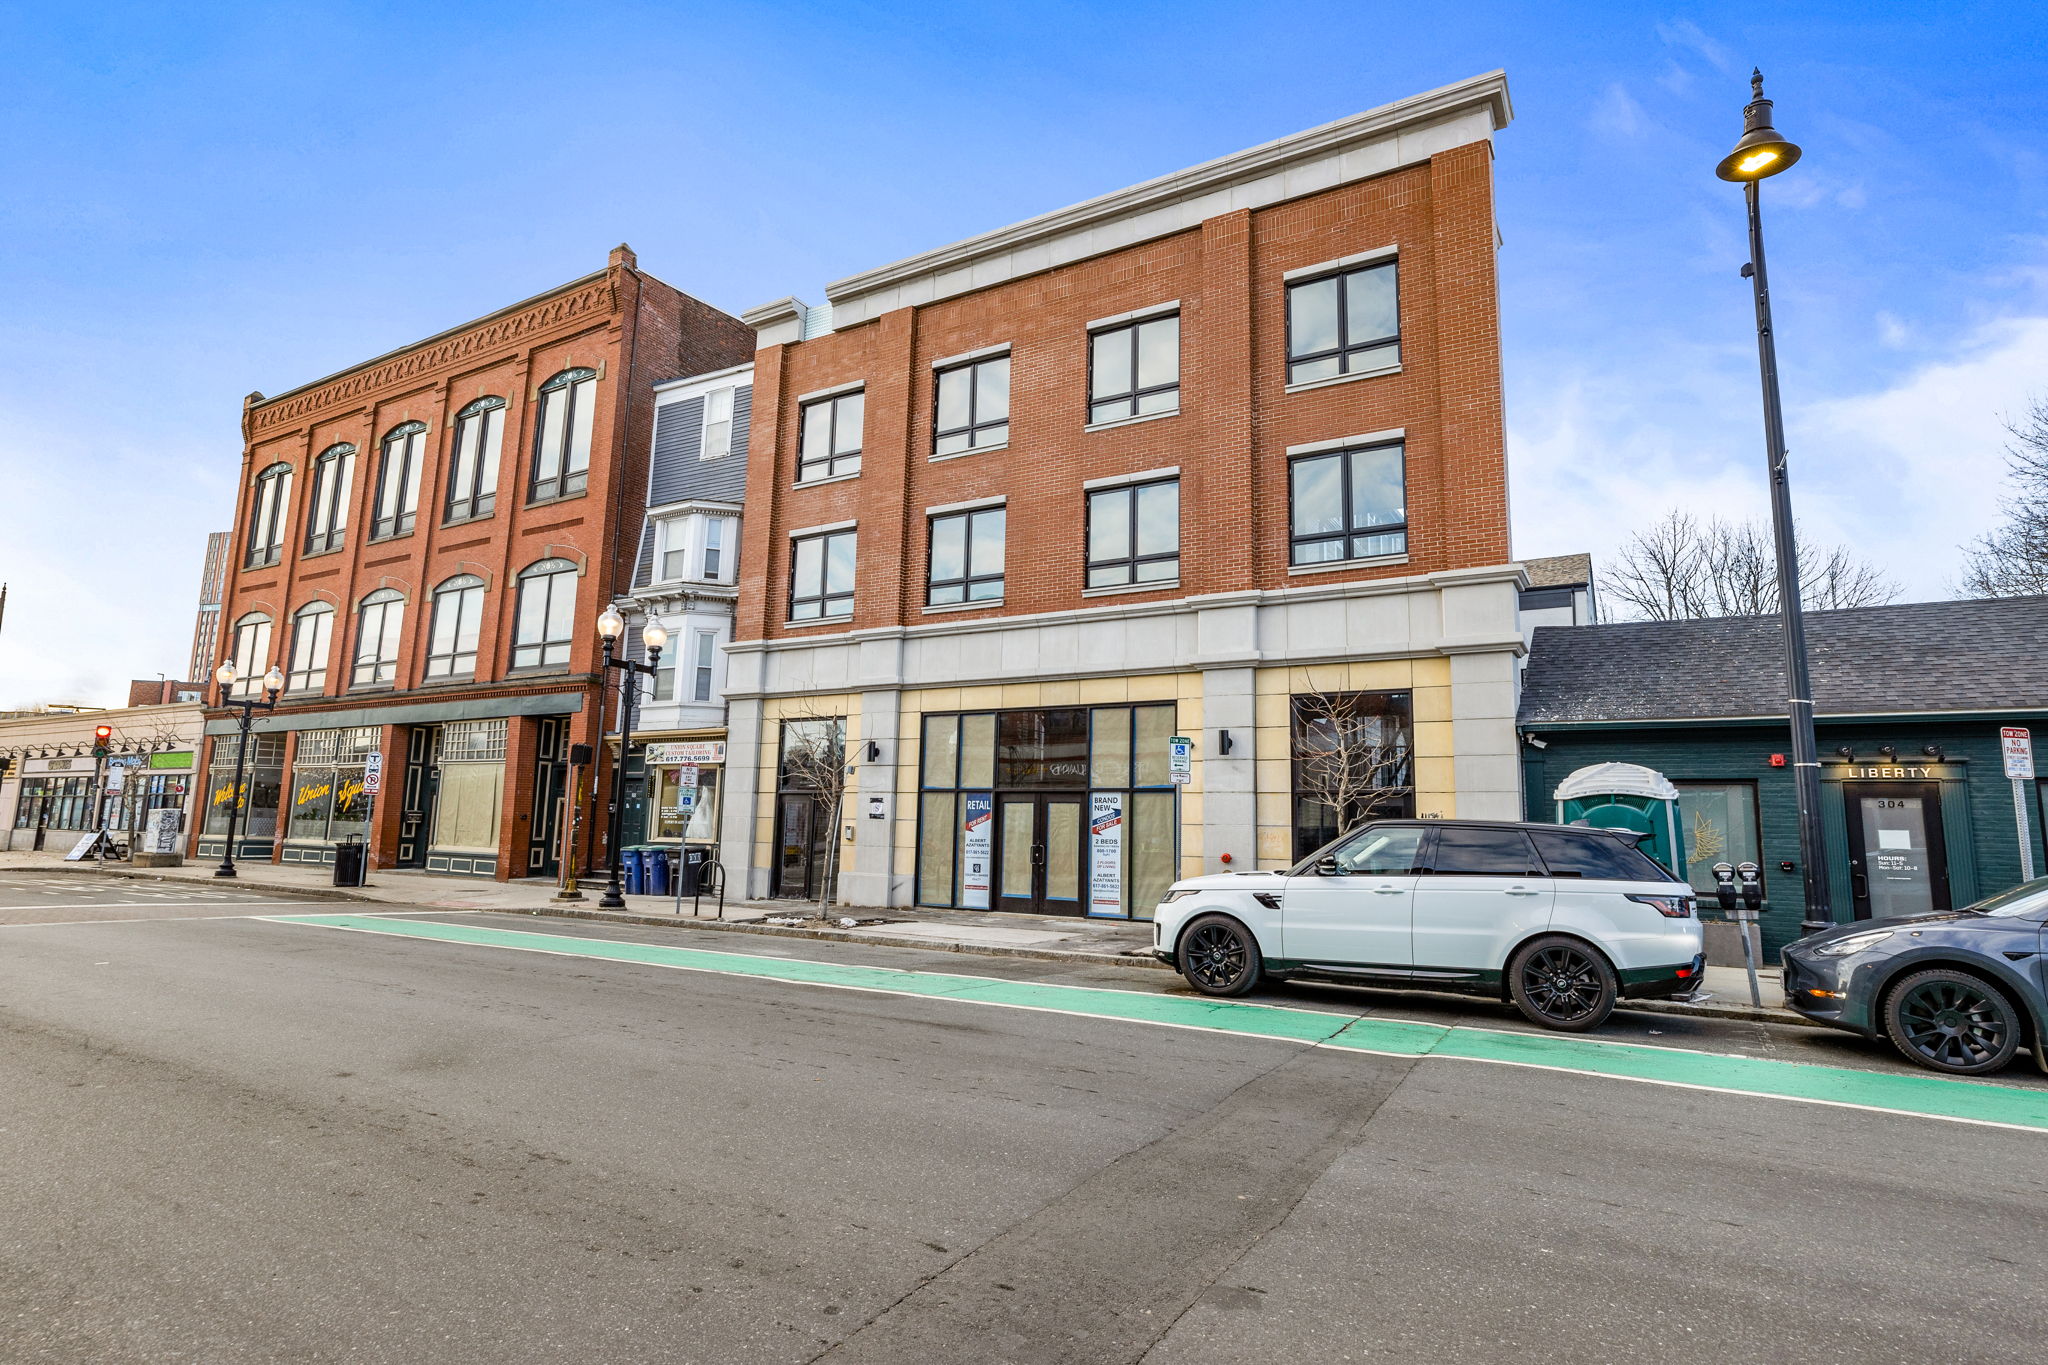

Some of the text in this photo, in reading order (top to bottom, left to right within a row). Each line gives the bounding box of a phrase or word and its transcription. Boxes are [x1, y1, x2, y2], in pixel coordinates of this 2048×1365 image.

[2006, 747, 2028, 755] PARKING
[1848, 768, 1932, 778] LIBERTY
[214, 782, 247, 806] Welce
[297, 783, 330, 805] Union
[967, 800, 990, 810] RETAIL
[1878, 800, 1904, 808] 304
[976, 814, 988, 823] RENT
[1096, 812, 1116, 824] CONDOS
[1097, 819, 1118, 831] FOR SALE
